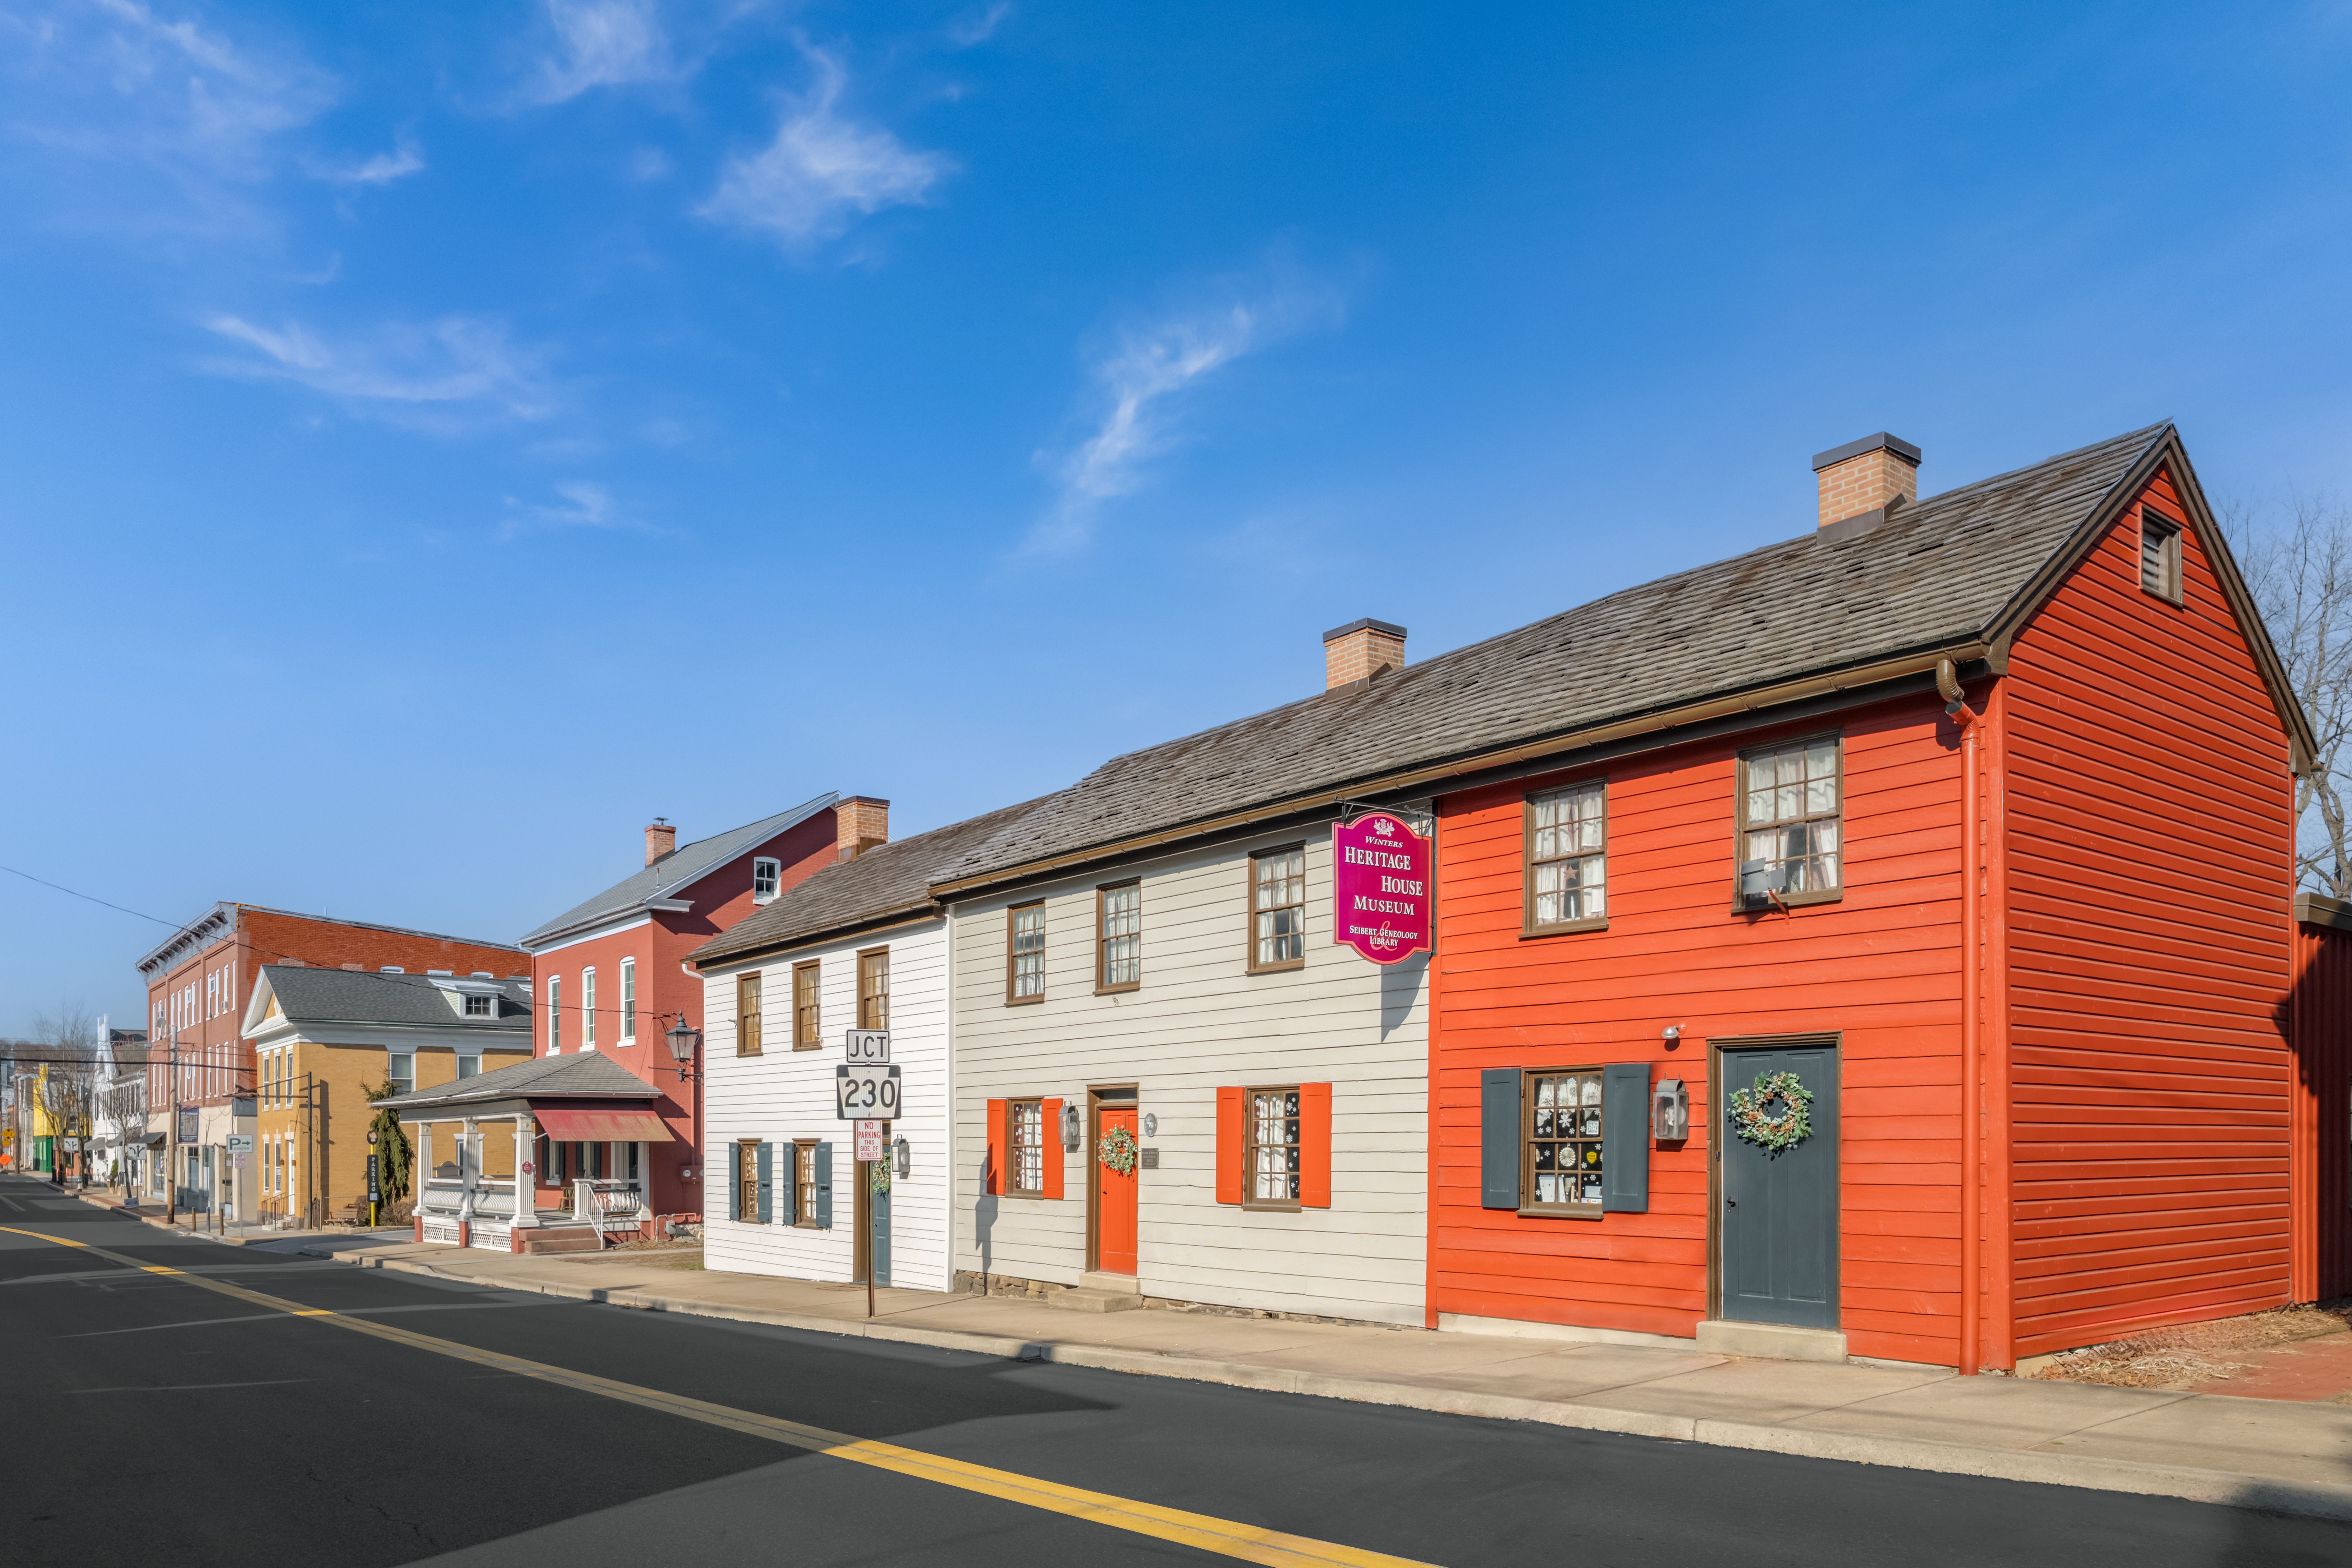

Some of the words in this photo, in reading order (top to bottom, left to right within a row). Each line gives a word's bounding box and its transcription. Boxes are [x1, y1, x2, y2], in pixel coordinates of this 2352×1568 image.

[1365, 836, 1403, 848] WINTERS
[1344, 846, 1411, 871] HERITAGE
[1381, 876, 1423, 896] HOUSE
[1353, 895, 1414, 915] MUSEUM
[1349, 925, 1377, 936] SEIBERT
[1379, 928, 1418, 940] GENEOLOGY
[1370, 936, 1398, 946] LIBRARY
[849, 1036, 887, 1057] JCT
[845, 1079, 895, 1108] 230
